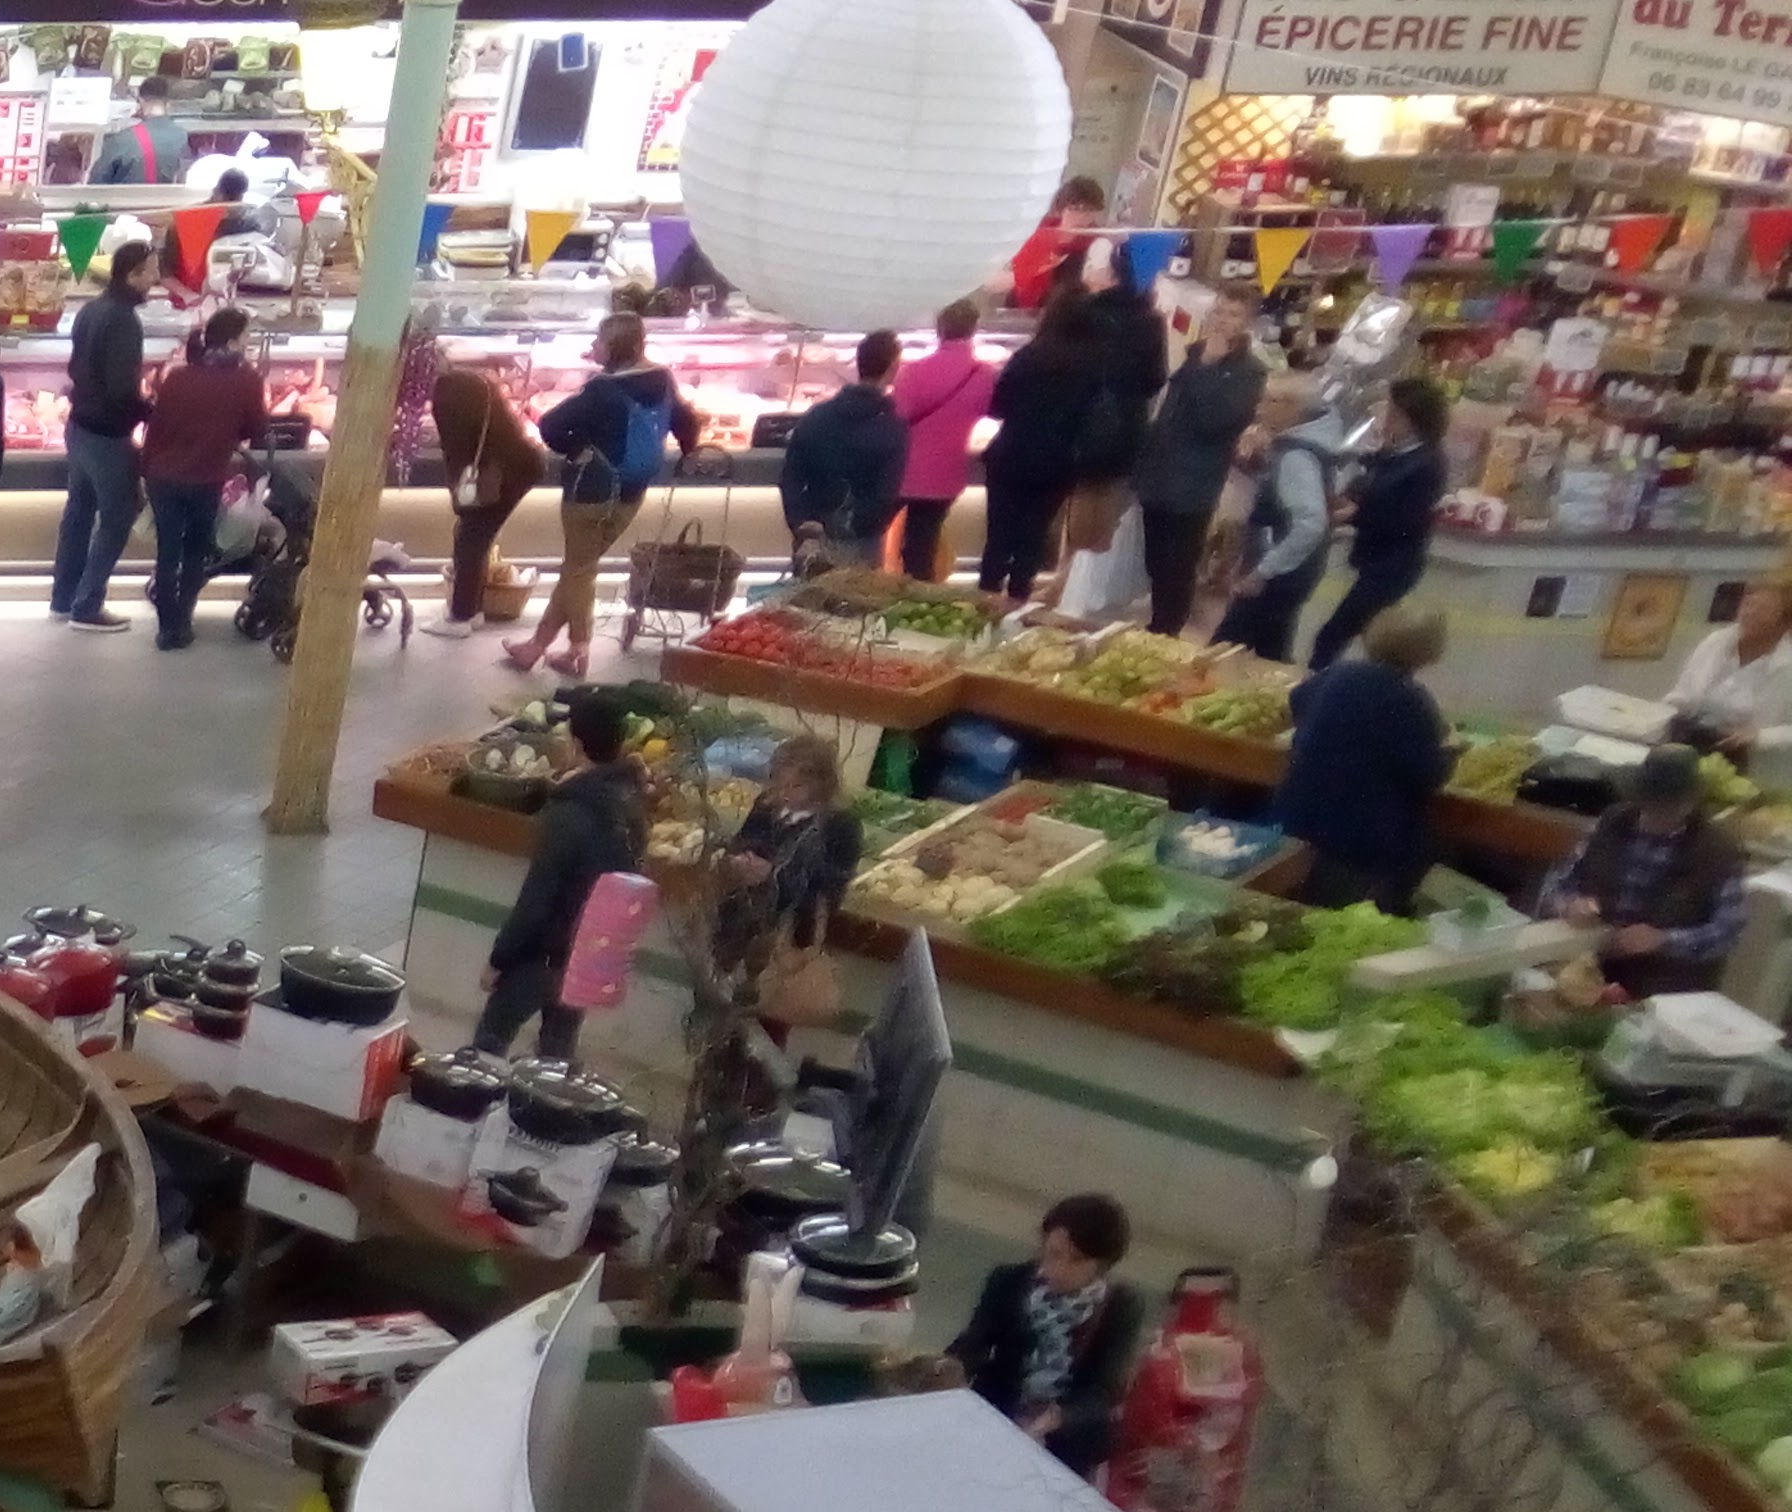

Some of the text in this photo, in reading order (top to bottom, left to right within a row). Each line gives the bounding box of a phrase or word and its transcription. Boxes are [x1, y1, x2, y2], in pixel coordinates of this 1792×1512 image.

[1254, 4, 1589, 51] ÉPICERIE FINE
[1713, 0, 1792, 47] Ter
[1305, 66, 1358, 87] VINS
